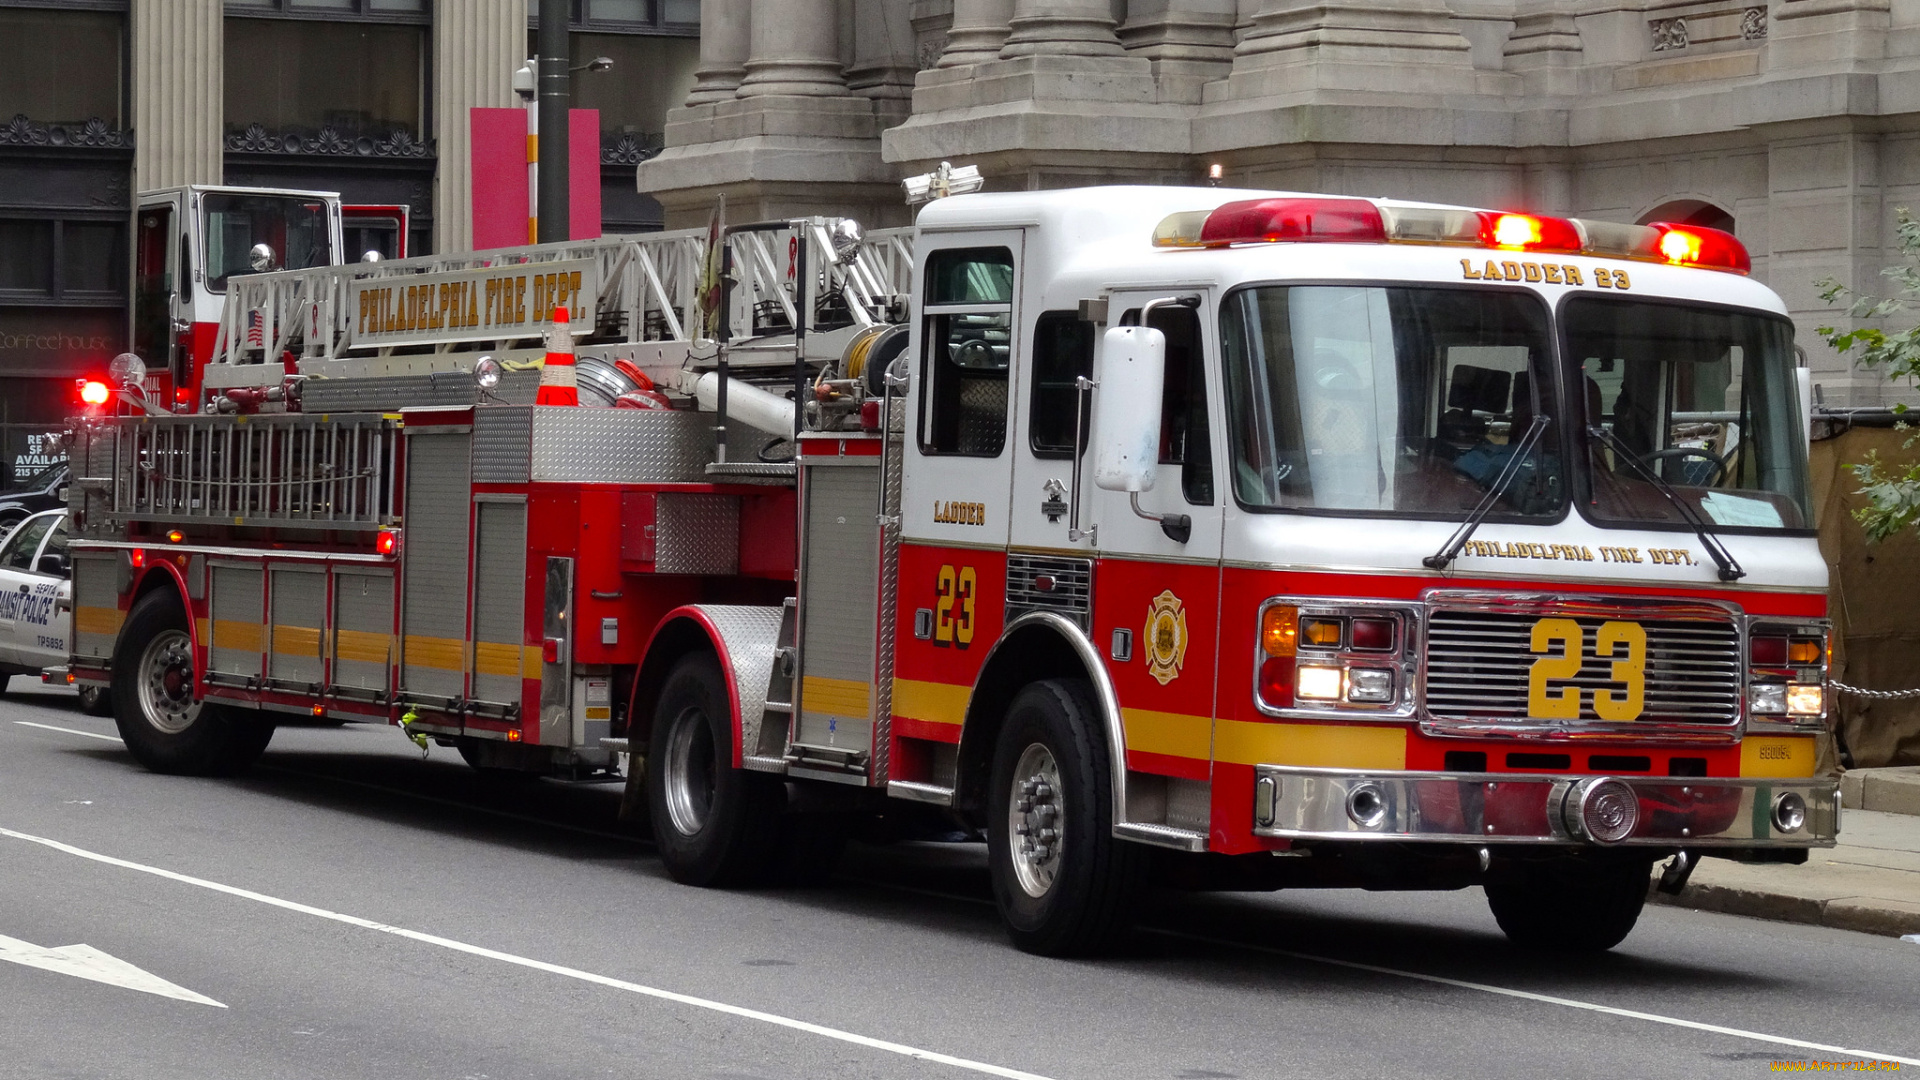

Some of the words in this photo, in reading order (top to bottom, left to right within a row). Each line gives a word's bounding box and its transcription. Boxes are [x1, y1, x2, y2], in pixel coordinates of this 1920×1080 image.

[1460, 259, 1584, 285] LADDER
[1594, 267, 1631, 290] 23
[359, 280, 479, 334] PHILADELPHIA
[485, 275, 526, 326] FIRE
[533, 271, 586, 323] DEPT.
[934, 500, 985, 526] LADDER
[1464, 539, 1595, 562] PHILADELPHIA
[1599, 546, 1643, 564] FIRE
[1649, 548, 1700, 567] DEPT.
[35, 583, 57, 596] SEPTA
[21, 594, 53, 625] POLICE
[934, 564, 976, 648] 23
[1528, 618, 1647, 721] 23
